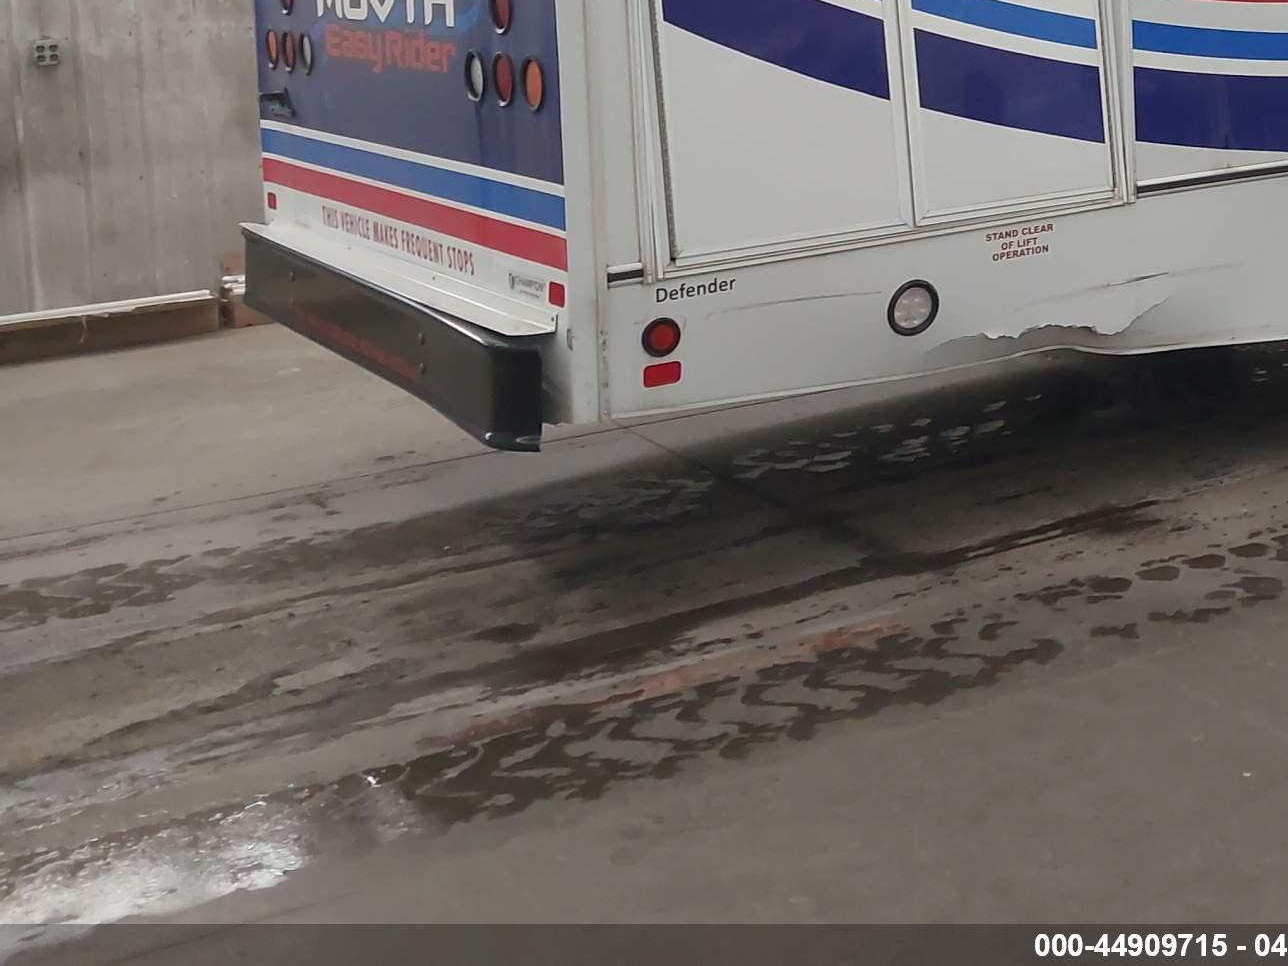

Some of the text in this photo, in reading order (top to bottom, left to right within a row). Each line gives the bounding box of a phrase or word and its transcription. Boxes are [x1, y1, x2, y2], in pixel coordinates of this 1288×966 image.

[321, 205, 475, 276] THIS VEHICLE MAKES FREQUENT STOPS
[985, 223, 1054, 242] STAND CLEAR
[992, 244, 1049, 262] OPERATION
[1001, 237, 1038, 251] OF LIFT
[655, 275, 737, 304] Defender
